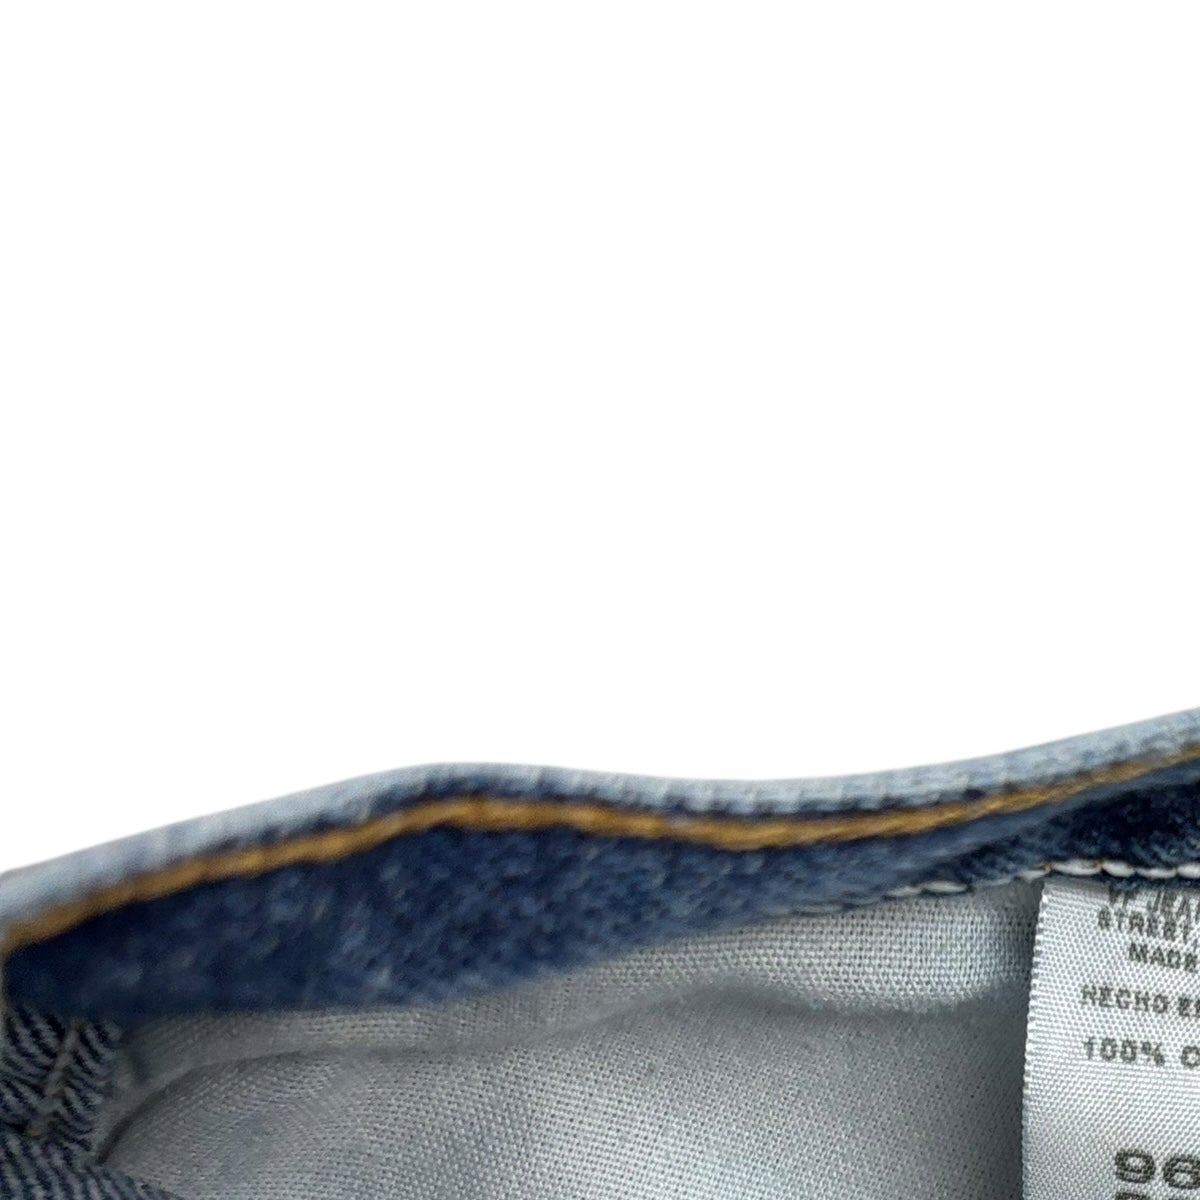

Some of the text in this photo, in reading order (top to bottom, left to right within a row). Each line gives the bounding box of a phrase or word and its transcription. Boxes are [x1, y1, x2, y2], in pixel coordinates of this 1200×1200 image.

[1129, 942, 1198, 974] MADE
[1083, 983, 1168, 1015] HECHO
[1084, 1036, 1165, 1067] 100%
